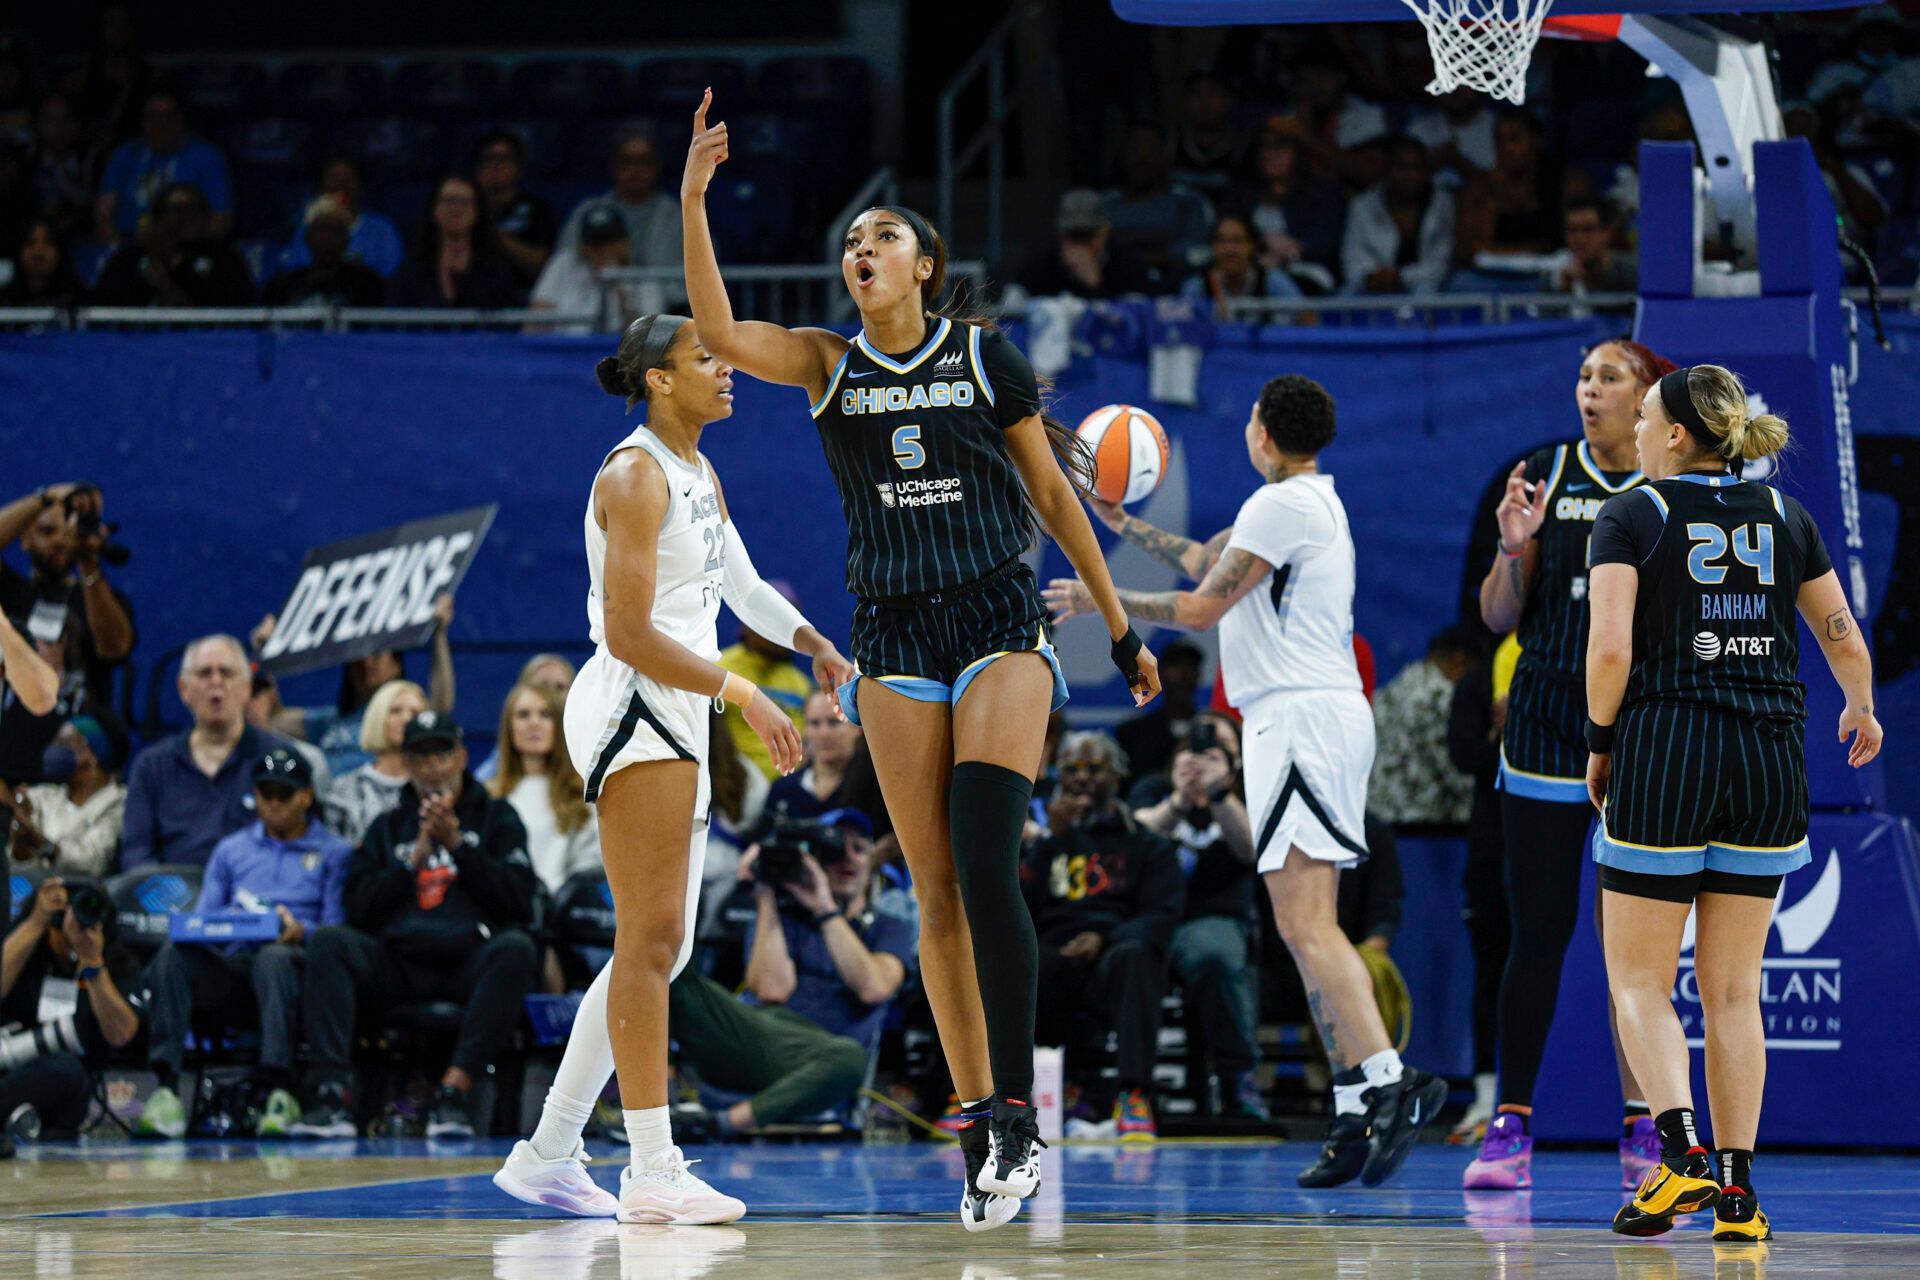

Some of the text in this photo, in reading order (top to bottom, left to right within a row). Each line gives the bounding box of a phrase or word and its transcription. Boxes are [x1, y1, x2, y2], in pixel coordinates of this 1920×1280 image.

[841, 381, 975, 416] CHICAGO
[892, 424, 927, 470] 5
[896, 478, 961, 494] UChicago
[898, 490, 963, 508] Medicine
[691, 491, 718, 523] ACE
[703, 523, 726, 572] 22
[1686, 522, 1775, 586] 24
[261, 530, 474, 660] DEFENSE
[1701, 593, 1766, 620] BANHAM
[1724, 636, 1775, 656] AT&T
